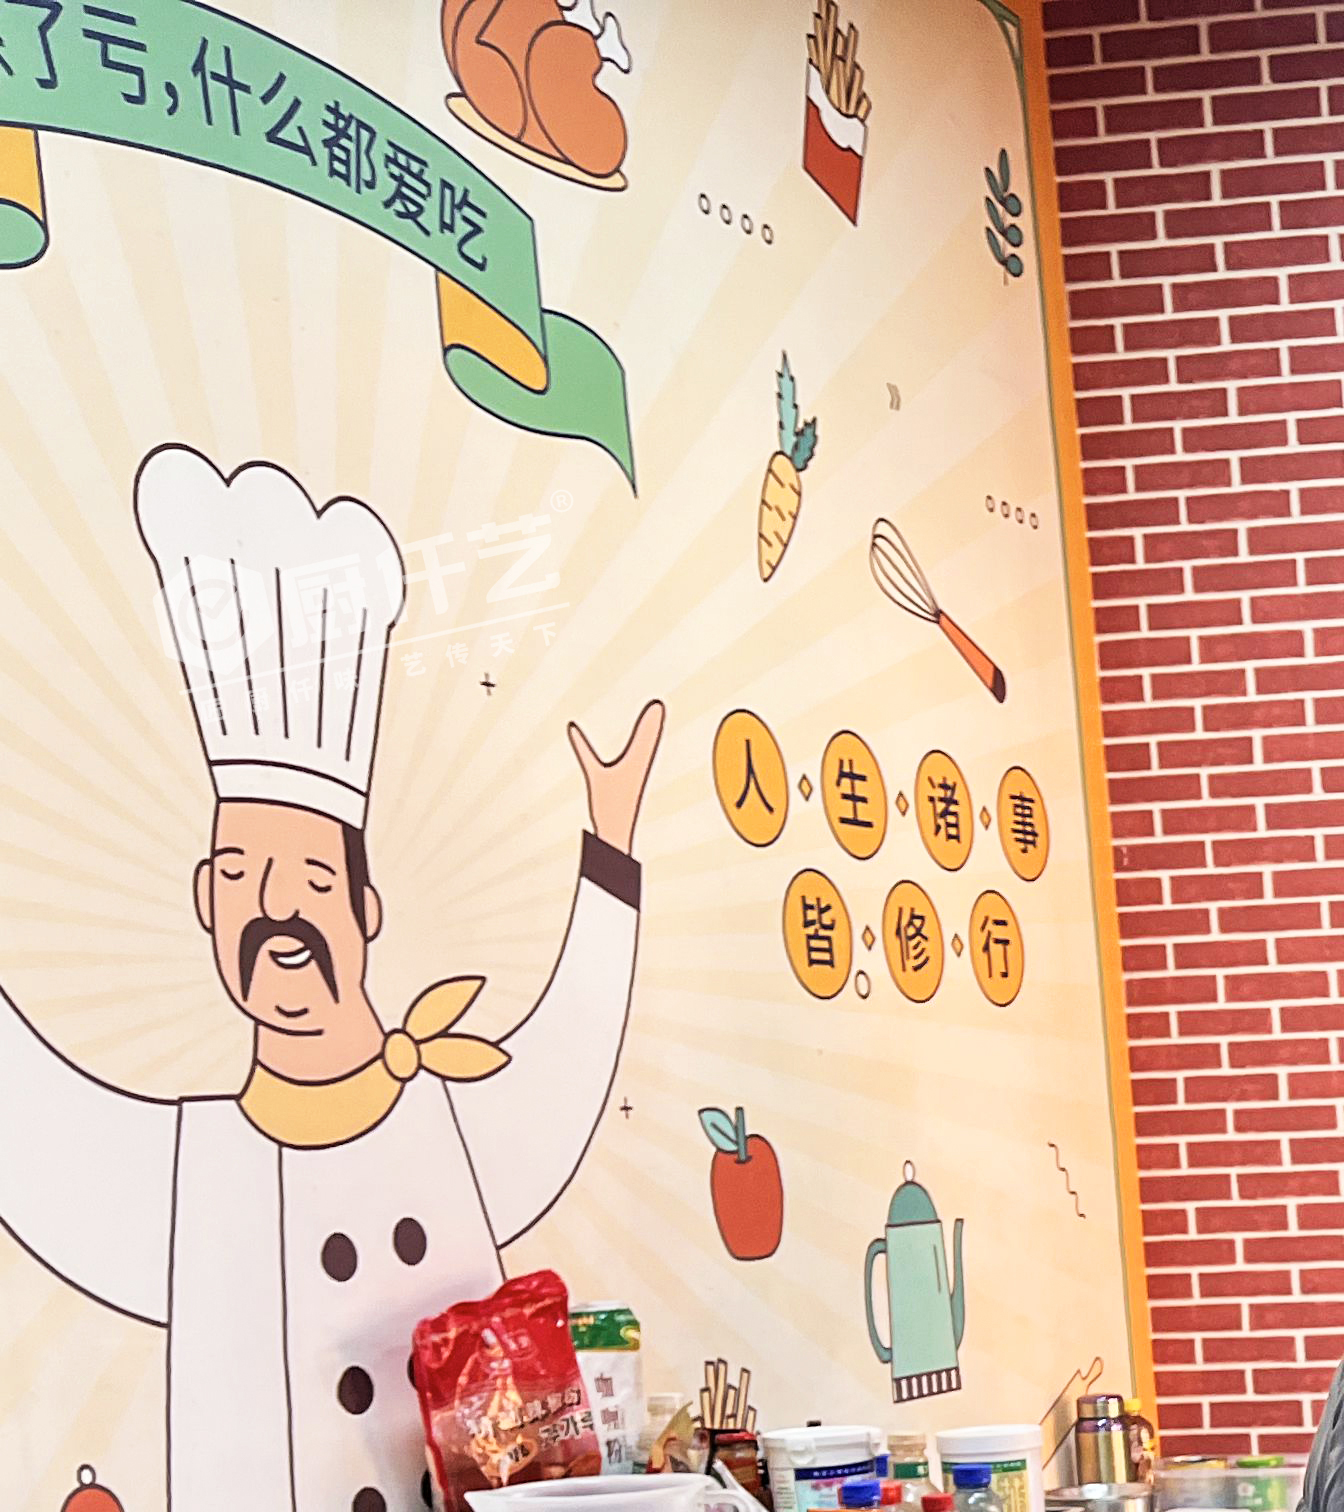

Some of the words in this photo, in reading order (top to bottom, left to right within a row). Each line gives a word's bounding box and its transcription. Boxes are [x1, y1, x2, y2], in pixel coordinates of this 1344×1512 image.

[0, 0, 488, 273] 了亏,什么都爱吃
[799, 895, 1011, 979] 皆修行
